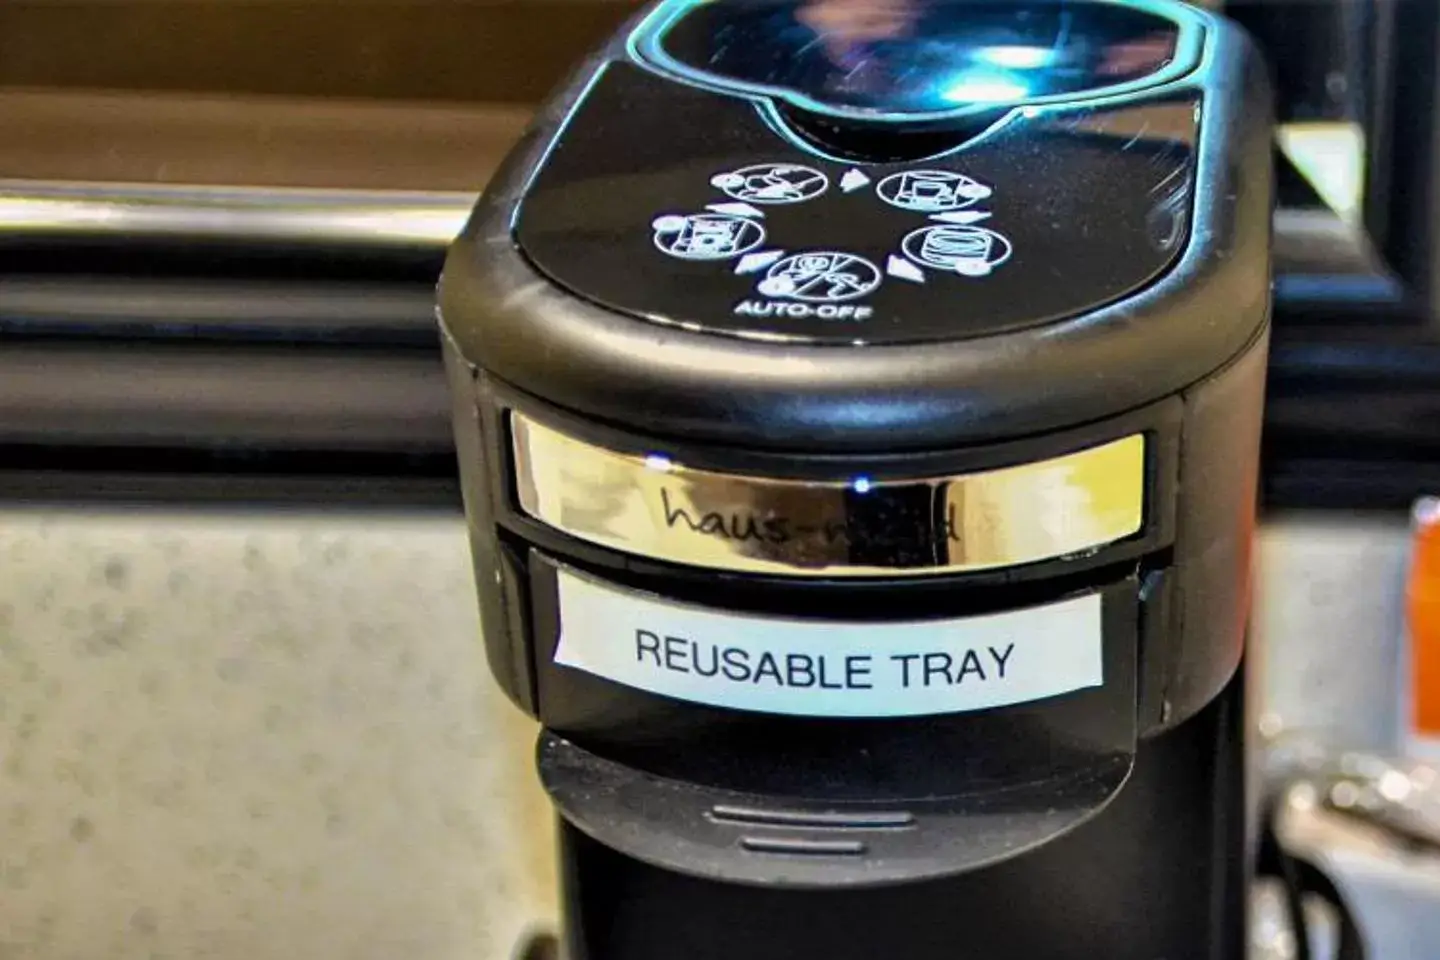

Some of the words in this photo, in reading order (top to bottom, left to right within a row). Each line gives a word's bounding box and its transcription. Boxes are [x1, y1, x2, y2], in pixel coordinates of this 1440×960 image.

[734, 300, 874, 320] AUTO-OFF
[635, 628, 873, 690] REUSABLE
[890, 643, 1016, 688] TRAY
